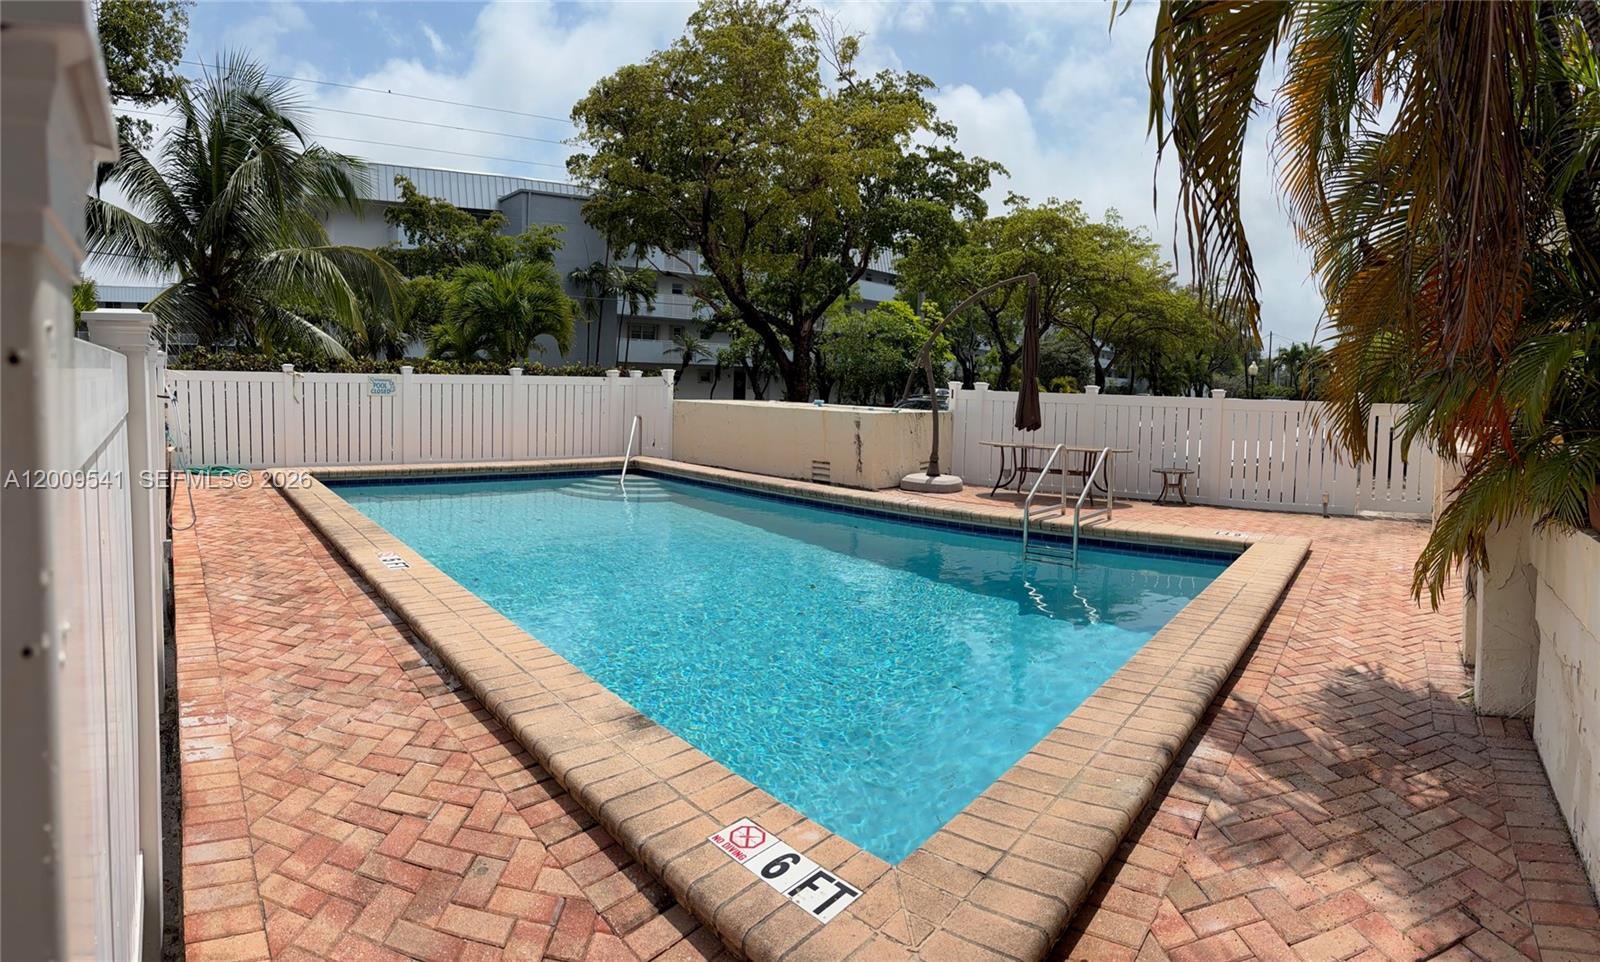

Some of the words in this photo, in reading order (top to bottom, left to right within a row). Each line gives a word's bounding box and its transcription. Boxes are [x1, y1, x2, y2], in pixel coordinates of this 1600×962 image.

[711, 834, 725, 844] NO
[721, 841, 747, 861] DIVING
[761, 853, 801, 879] 6
[787, 870, 859, 915] FT
